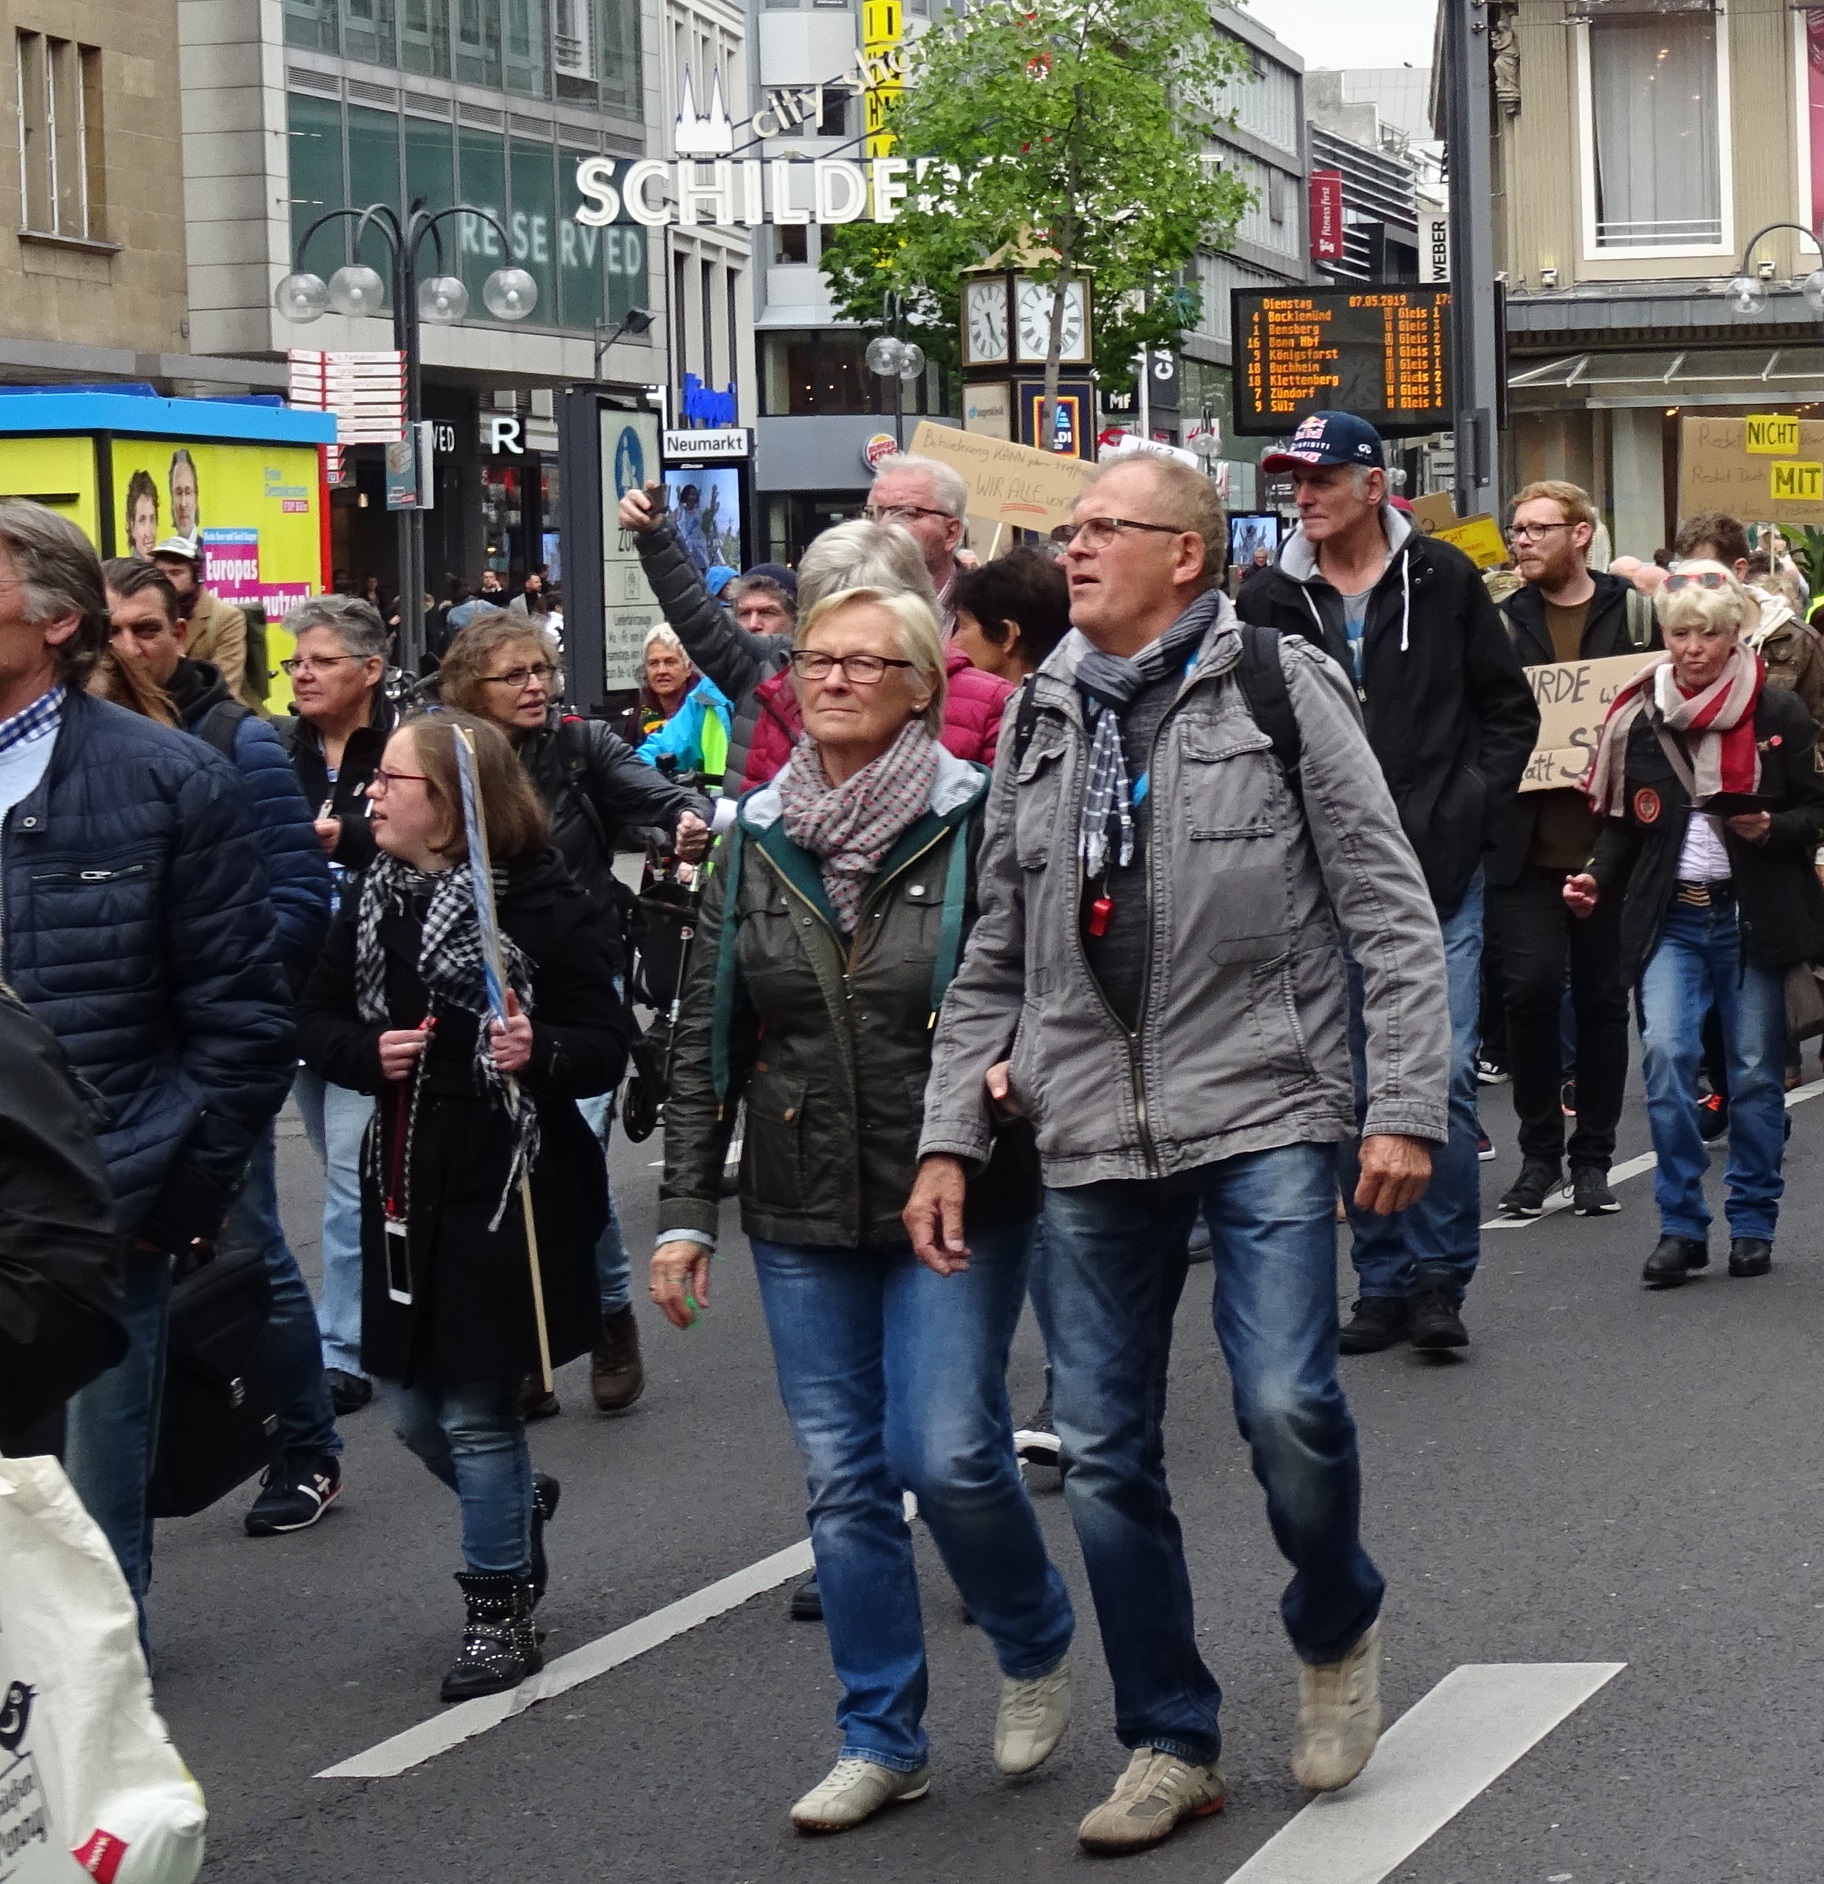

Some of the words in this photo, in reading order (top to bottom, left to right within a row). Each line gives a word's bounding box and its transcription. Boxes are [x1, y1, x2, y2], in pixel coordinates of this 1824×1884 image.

[752, 84, 823, 138] city
[843, 49, 915, 97] sho
[1321, 186, 1330, 205] first
[1321, 206, 1332, 236] fitness
[460, 202, 642, 276] RESERVED
[1431, 220, 1447, 281] WEBER
[1263, 298, 1313, 310] Dienstag
[1349, 294, 1406, 307] 07.05.2019
[1268, 310, 1332, 322] Bocklemünd
[1398, 308, 1427, 319] Gleis
[1433, 308, 1440, 318] 1
[1269, 324, 1320, 336] Bensberg
[1398, 320, 1428, 331] Gleis
[1433, 320, 1441, 330] 3
[1269, 337, 1295, 348] Bonn
[1300, 336, 1320, 347] Hbf
[1399, 333, 1428, 345] Gleis
[1434, 333, 1441, 343] 2
[1269, 349, 1339, 361] Königsforst
[1399, 346, 1428, 357] Gleis
[1434, 346, 1441, 356] 3
[1400, 359, 1429, 370] Gleis
[1435, 359, 1441, 369] 1
[1270, 375, 1339, 387] Klettenberg
[1400, 372, 1429, 382] Gleis
[1434, 371, 1442, 381] 2
[1270, 388, 1315, 399] Zündorf
[1400, 384, 1429, 395] Gleis
[1435, 385, 1442, 394] 3
[1271, 400, 1295, 411] Sülz
[1400, 397, 1430, 408] Gleis
[1435, 397, 1442, 407] 4
[491, 418, 524, 454] R
[1748, 422, 1797, 445] NICHT
[667, 435, 743, 452] Neumarkt
[976, 474, 1005, 498] WIR
[1008, 477, 1046, 503] ALLE
[1775, 467, 1821, 494] MIT
[205, 551, 258, 588] Europas
